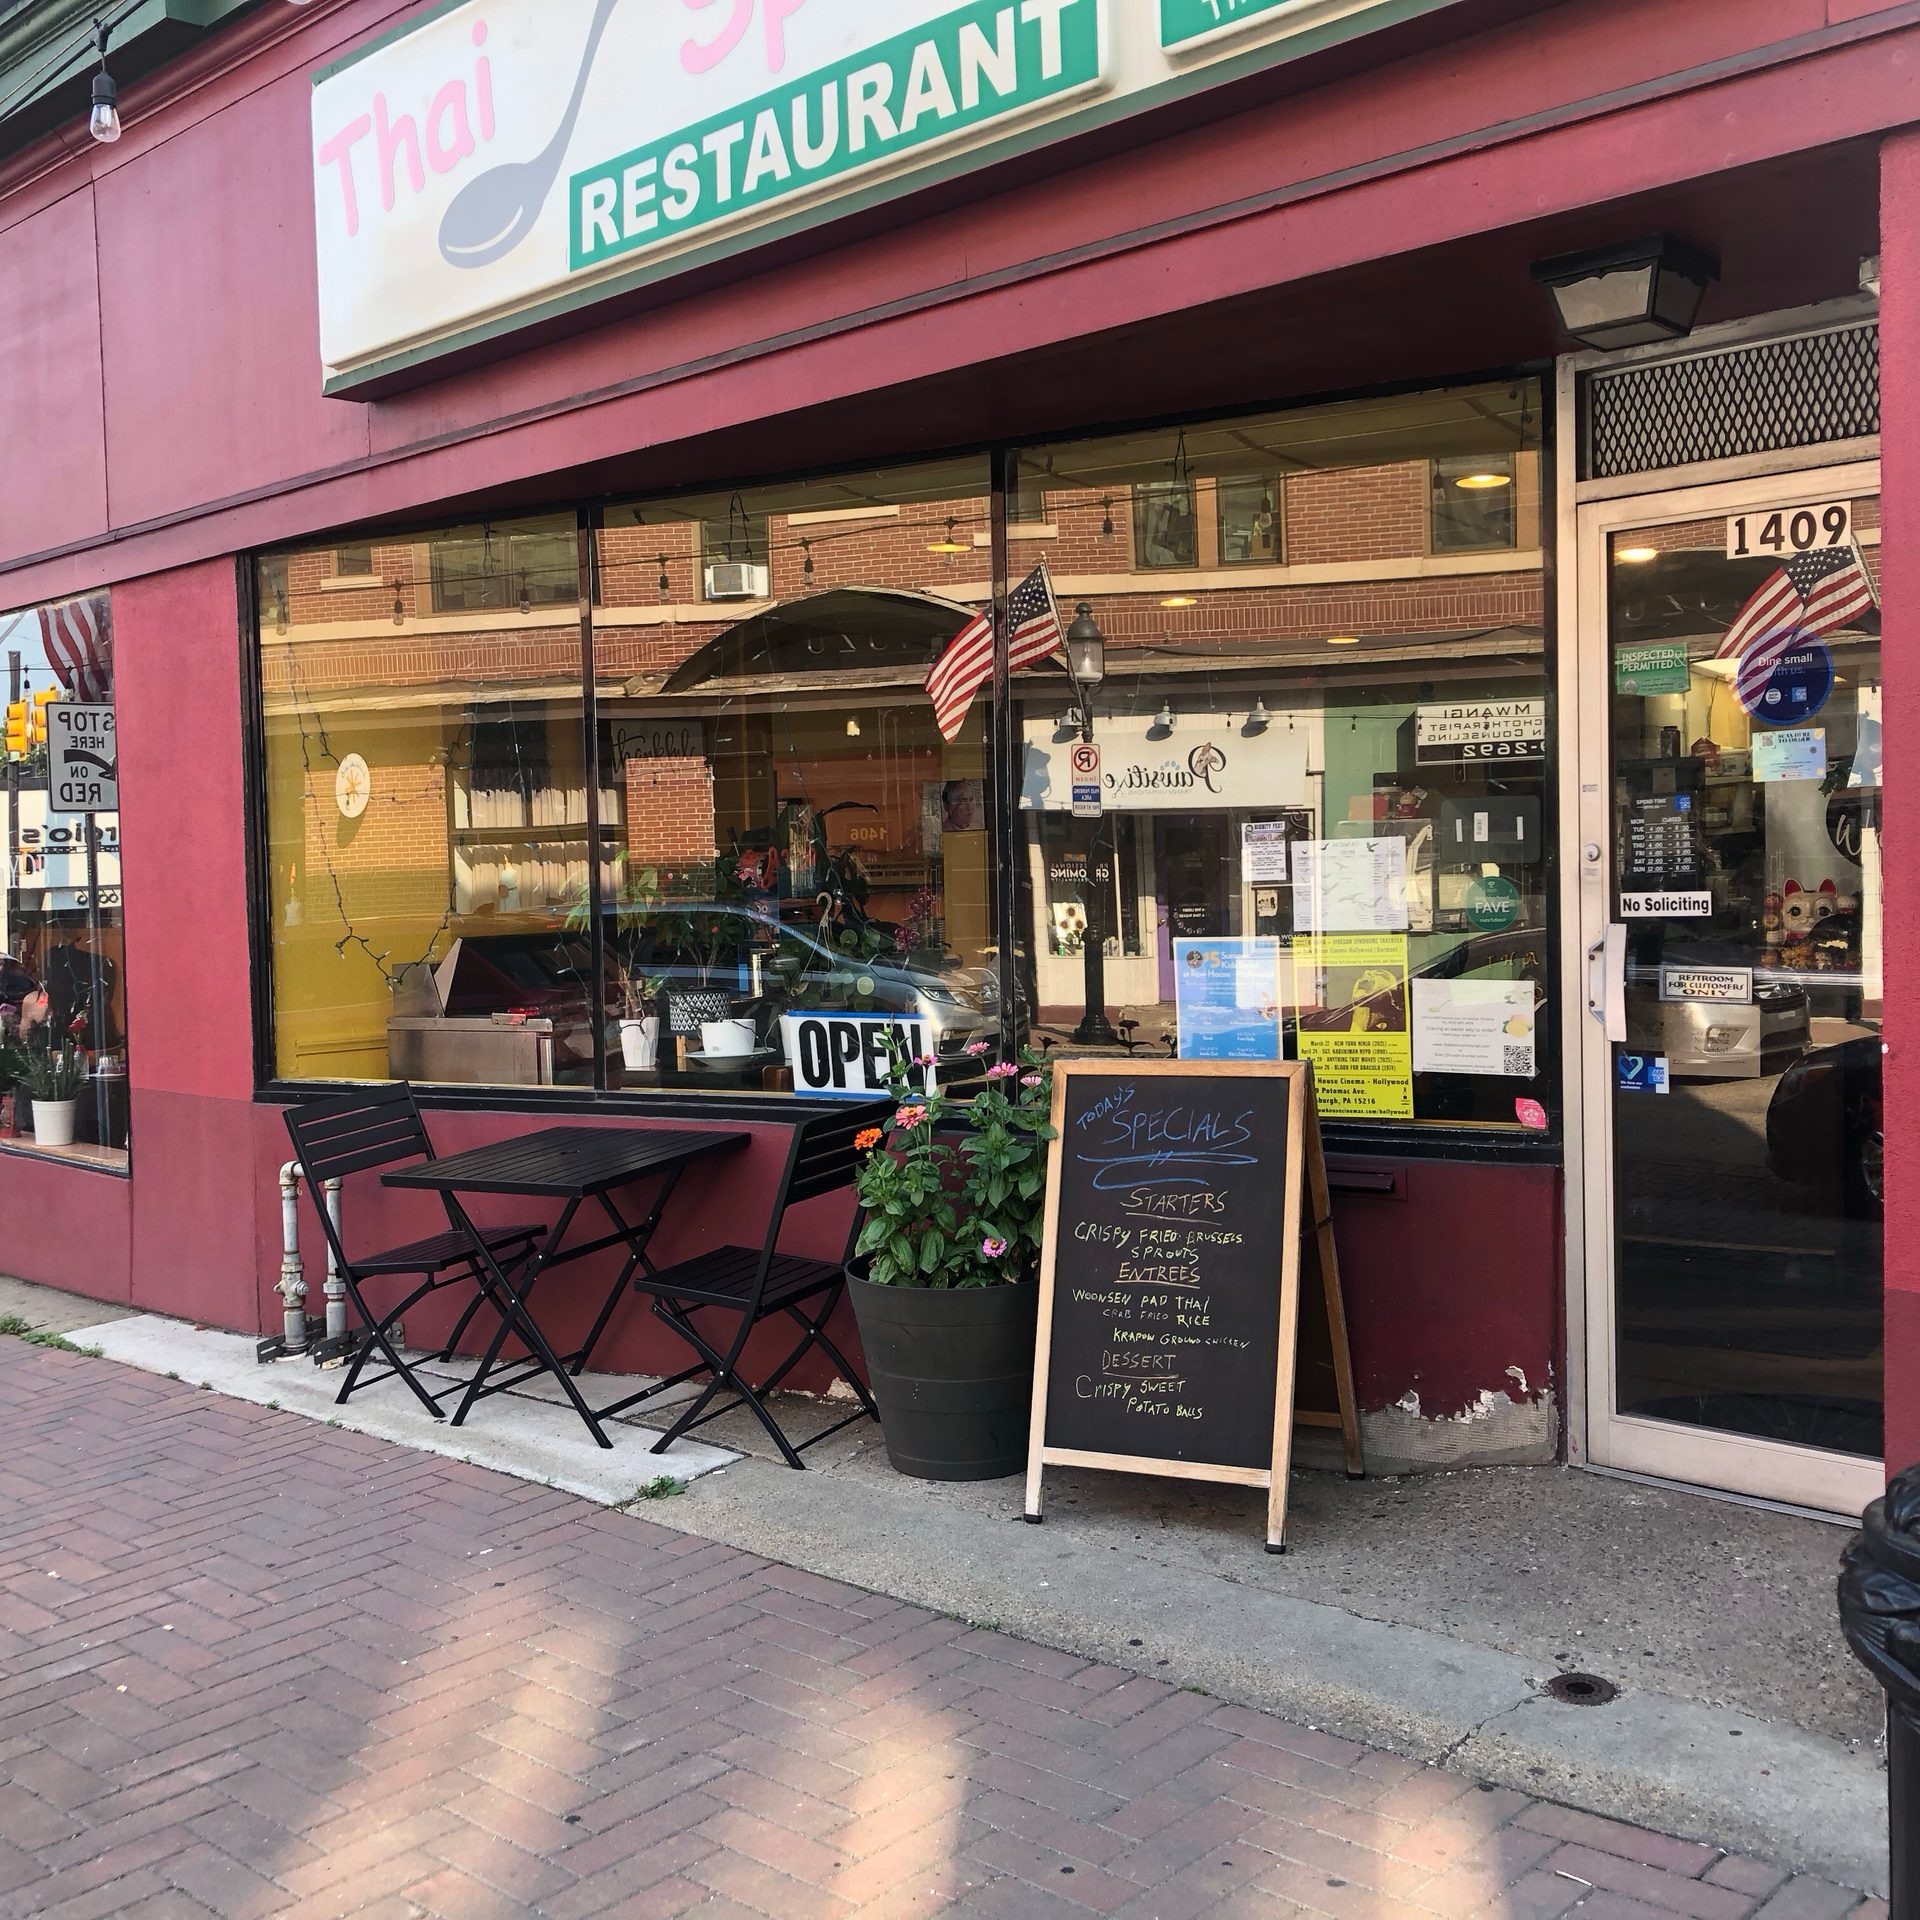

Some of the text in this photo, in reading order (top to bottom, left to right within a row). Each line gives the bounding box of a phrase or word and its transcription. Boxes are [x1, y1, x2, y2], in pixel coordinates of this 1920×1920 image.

[319, 20, 496, 238] Thai
[581, 0, 1080, 254] RESTAURANT
[1734, 506, 1848, 556] 1409
[1622, 649, 1688, 668] INSPECTED &
[1622, 659, 1674, 673] PERMITTED
[1758, 652, 1814, 668] Dine small
[1475, 901, 1510, 914] FAVE
[1623, 896, 1709, 914] No Soliciting
[1207, 969, 1231, 978] House
[1678, 974, 1734, 983] RESTROOM
[1668, 981, 1744, 991] FOR CUSTOMERS
[1682, 988, 1729, 996] ONLY
[799, 1019, 924, 1090] OPEN
[1317, 1077, 1409, 1087] House Cinema Hollywood
[1352, 1087, 1368, 1095] Ave.
[1076, 1082, 1136, 1131] TODAY'S
[1354, 1097, 1376, 1105] 15216
[1102, 1107, 1253, 1151] SPECIALS
[1120, 1187, 1228, 1215] STARTERS
[1074, 1221, 1243, 1248] CRISPY FRIED BRUSSELS
[1131, 1246, 1200, 1264] SPROUTS
[1119, 1261, 1201, 1283] ENTREES
[1072, 1288, 1210, 1314] WOONSEN PAD THAI
[1102, 1307, 1211, 1328] CRAB FRIED RICE
[1113, 1327, 1251, 1349] KRAPOW GROUND CHICKEN
[1102, 1349, 1177, 1370] DESSERT
[1139, 1379, 1187, 1394] SWEET
[1126, 1396, 1205, 1420] POTATO BALLS
